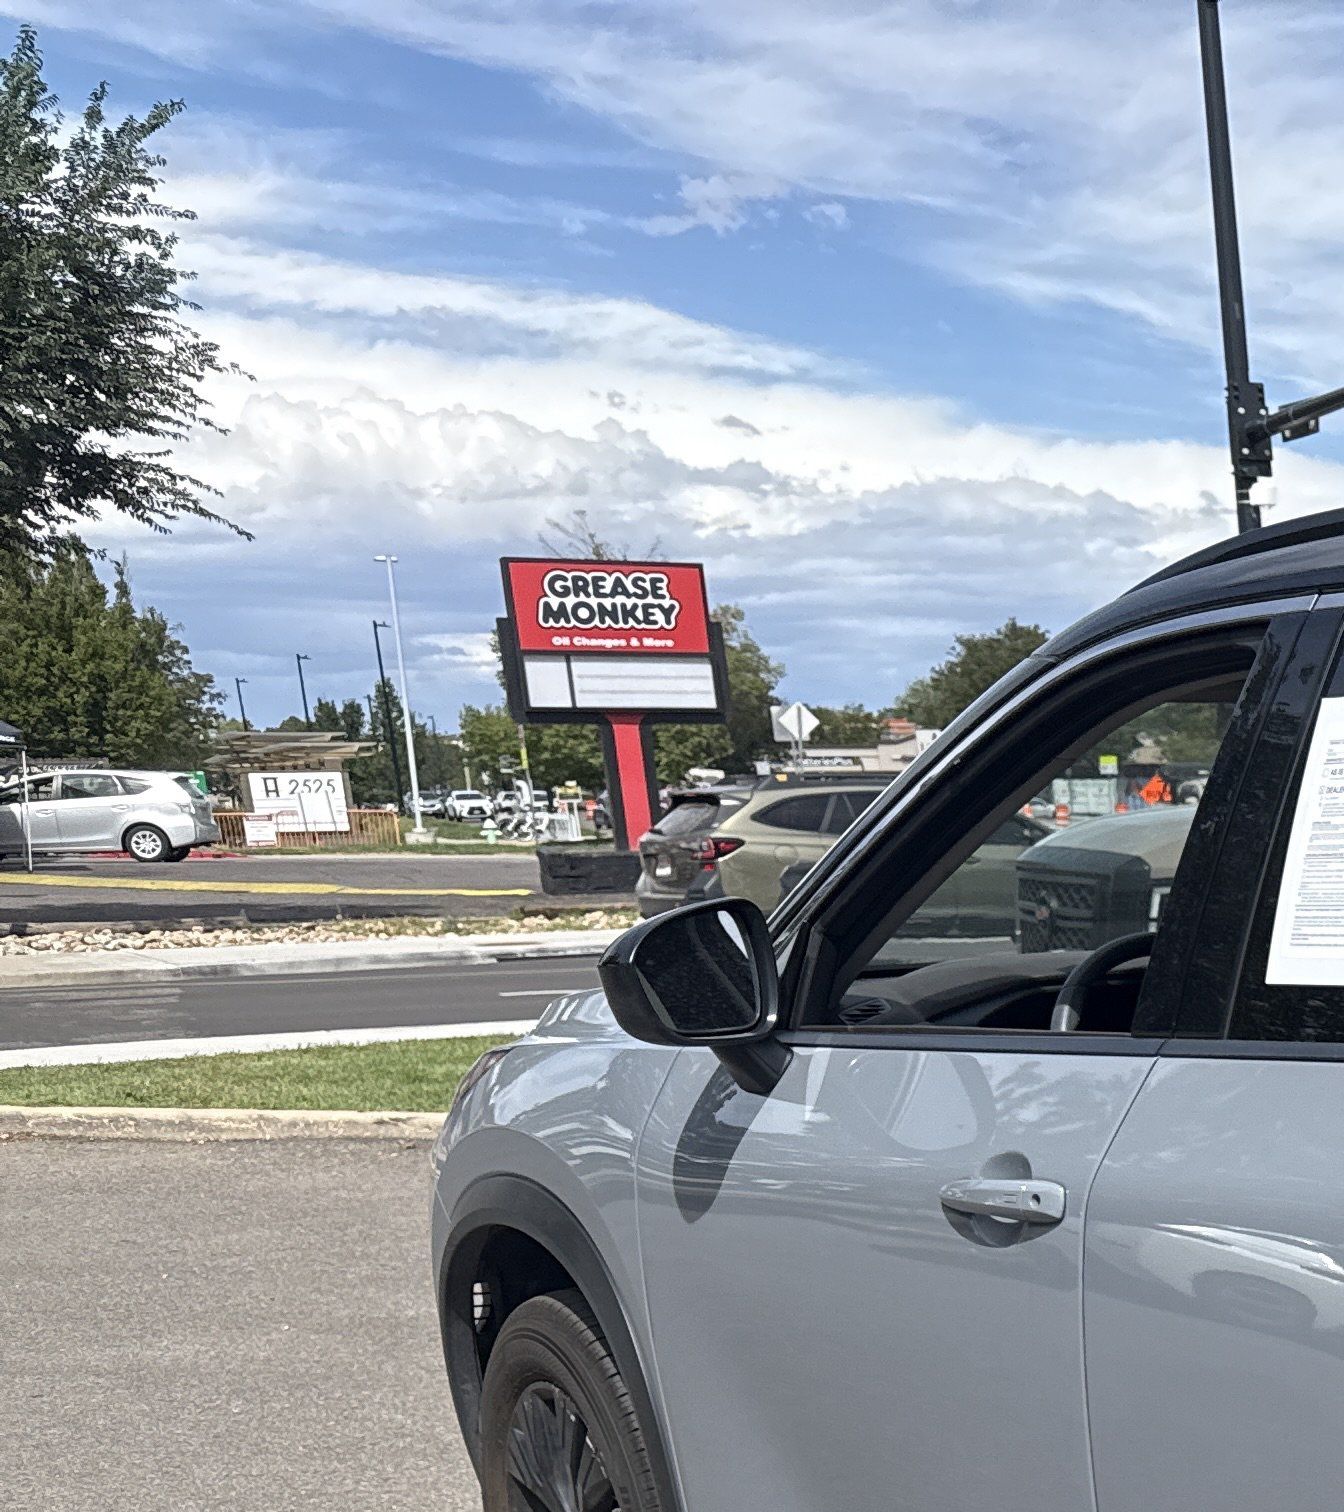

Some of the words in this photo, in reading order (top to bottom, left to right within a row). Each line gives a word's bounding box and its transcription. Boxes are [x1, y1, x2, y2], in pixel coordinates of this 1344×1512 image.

[547, 573, 667, 600] GREASE
[542, 600, 676, 627] MONKEY
[552, 636, 571, 646] Oil
[572, 636, 627, 648] Changes
[629, 637, 641, 647] &
[643, 637, 675, 647] More
